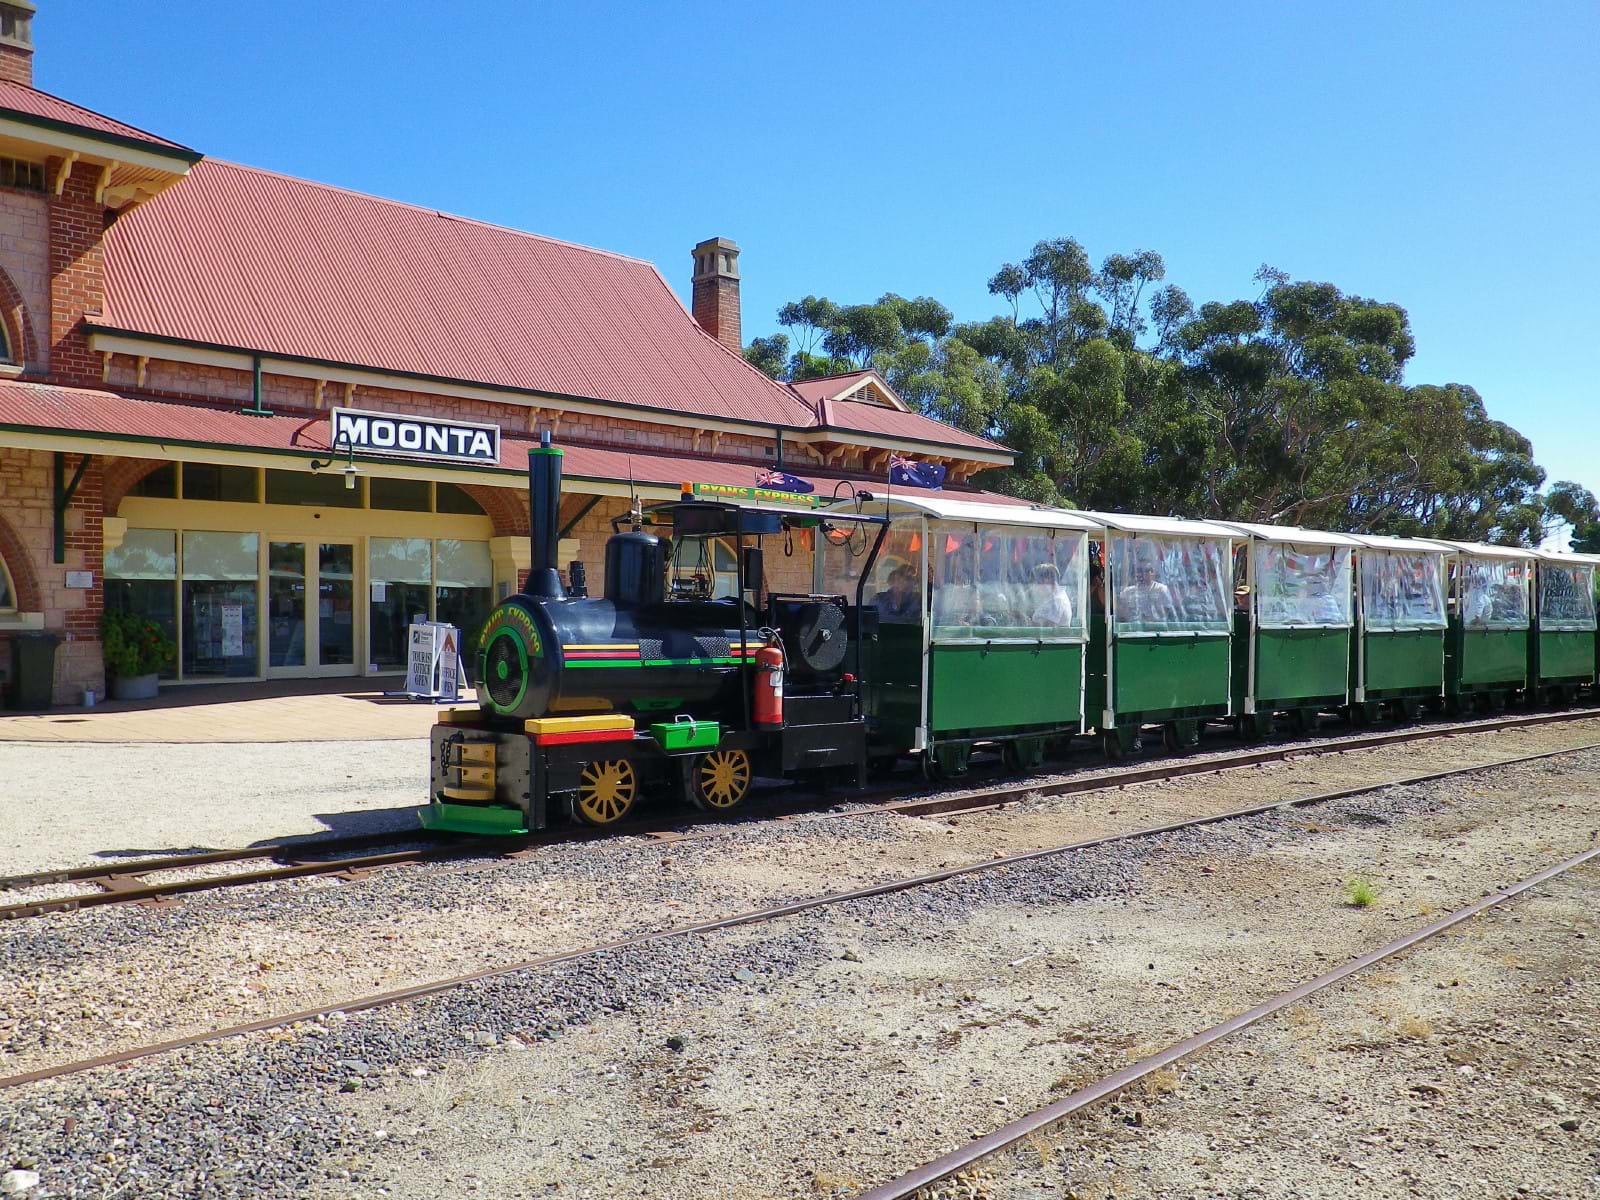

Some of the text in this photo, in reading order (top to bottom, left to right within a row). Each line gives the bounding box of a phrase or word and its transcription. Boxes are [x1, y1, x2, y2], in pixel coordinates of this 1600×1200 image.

[339, 415, 493, 456] MOONTA
[699, 484, 815, 504] RYANS EXPRESS
[412, 651, 432, 664] TOURIST
[413, 662, 431, 675] OFFICE
[441, 667, 456, 680] FFICE
[414, 674, 429, 687] OPEN
[444, 681, 454, 693] PEN
